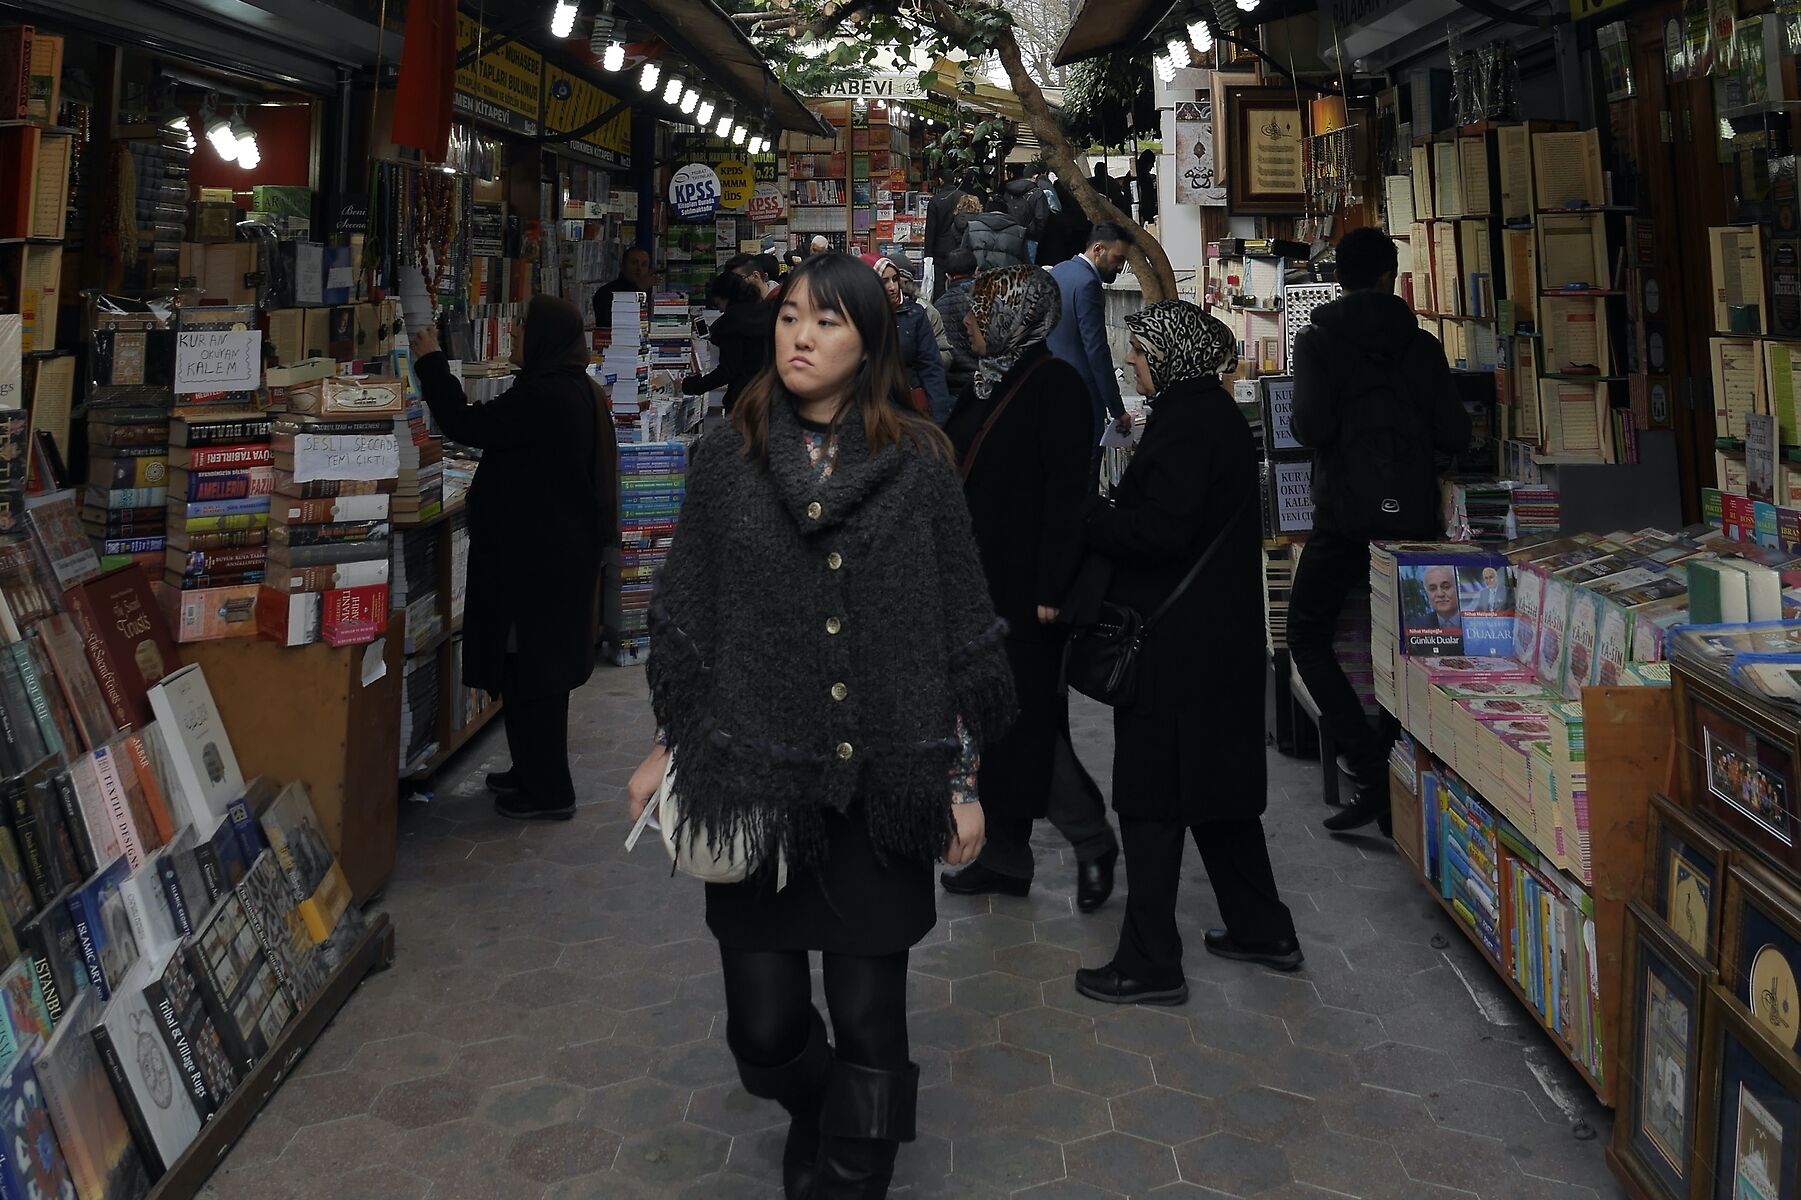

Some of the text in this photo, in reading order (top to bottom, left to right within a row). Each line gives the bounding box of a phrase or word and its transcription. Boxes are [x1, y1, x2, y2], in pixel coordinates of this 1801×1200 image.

[475, 100, 510, 124] KİTAPEVİ
[720, 166, 743, 175] KPDS
[675, 180, 715, 203] KPSS
[724, 191, 742, 201] ÜDS
[748, 196, 779, 212] KPSS
[187, 361, 237, 377] KALEM
[207, 451, 251, 464] TABİRLERİ
[1410, 636, 1460, 645] Günlük Dualar
[1466, 628, 1512, 640] DUALAR
[133, 737, 149, 770] AKBAR
[103, 774, 124, 820] TEXTILE
[119, 822, 141, 869] DESIGNS
[170, 883, 182, 910] ISLAMIC
[77, 922, 91, 964] ISLAMIC
[89, 964, 103, 987] ART
[159, 997, 207, 1100] Tribal & Village Rugs
